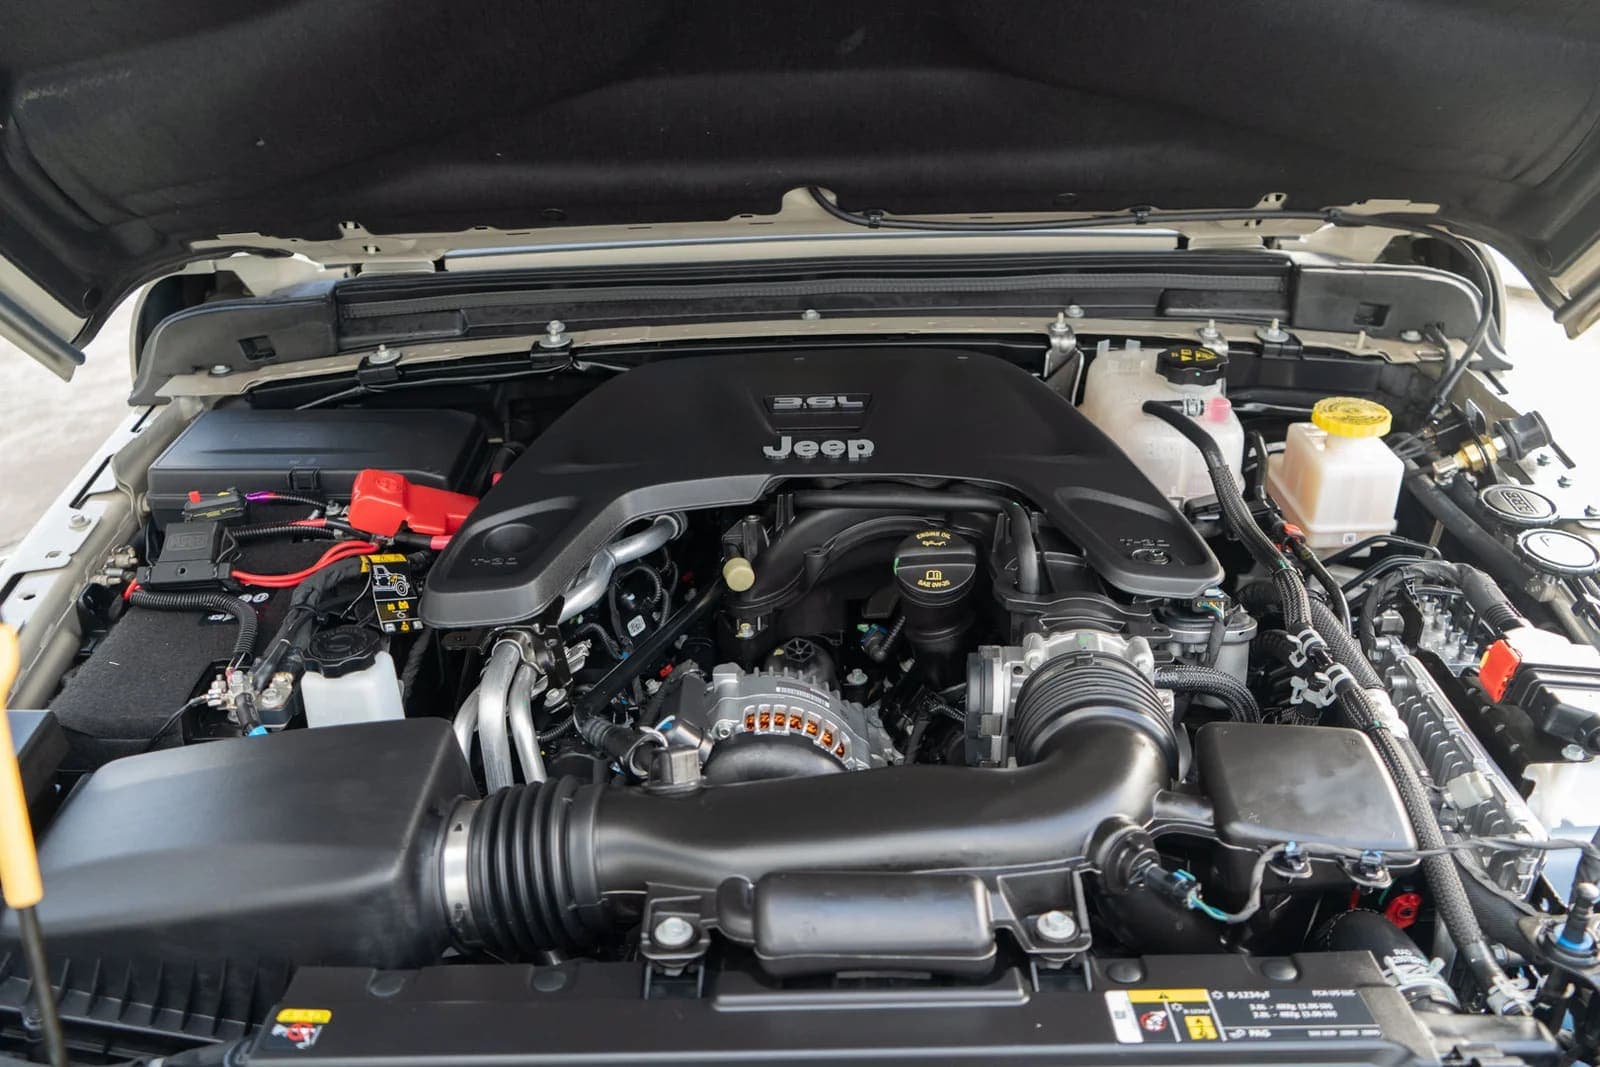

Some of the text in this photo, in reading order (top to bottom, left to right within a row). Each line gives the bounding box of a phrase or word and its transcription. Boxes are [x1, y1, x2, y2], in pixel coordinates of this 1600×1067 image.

[773, 396, 864, 410] 3.6L
[762, 436, 875, 461] Jeep
[916, 531, 941, 540] ENGINE
